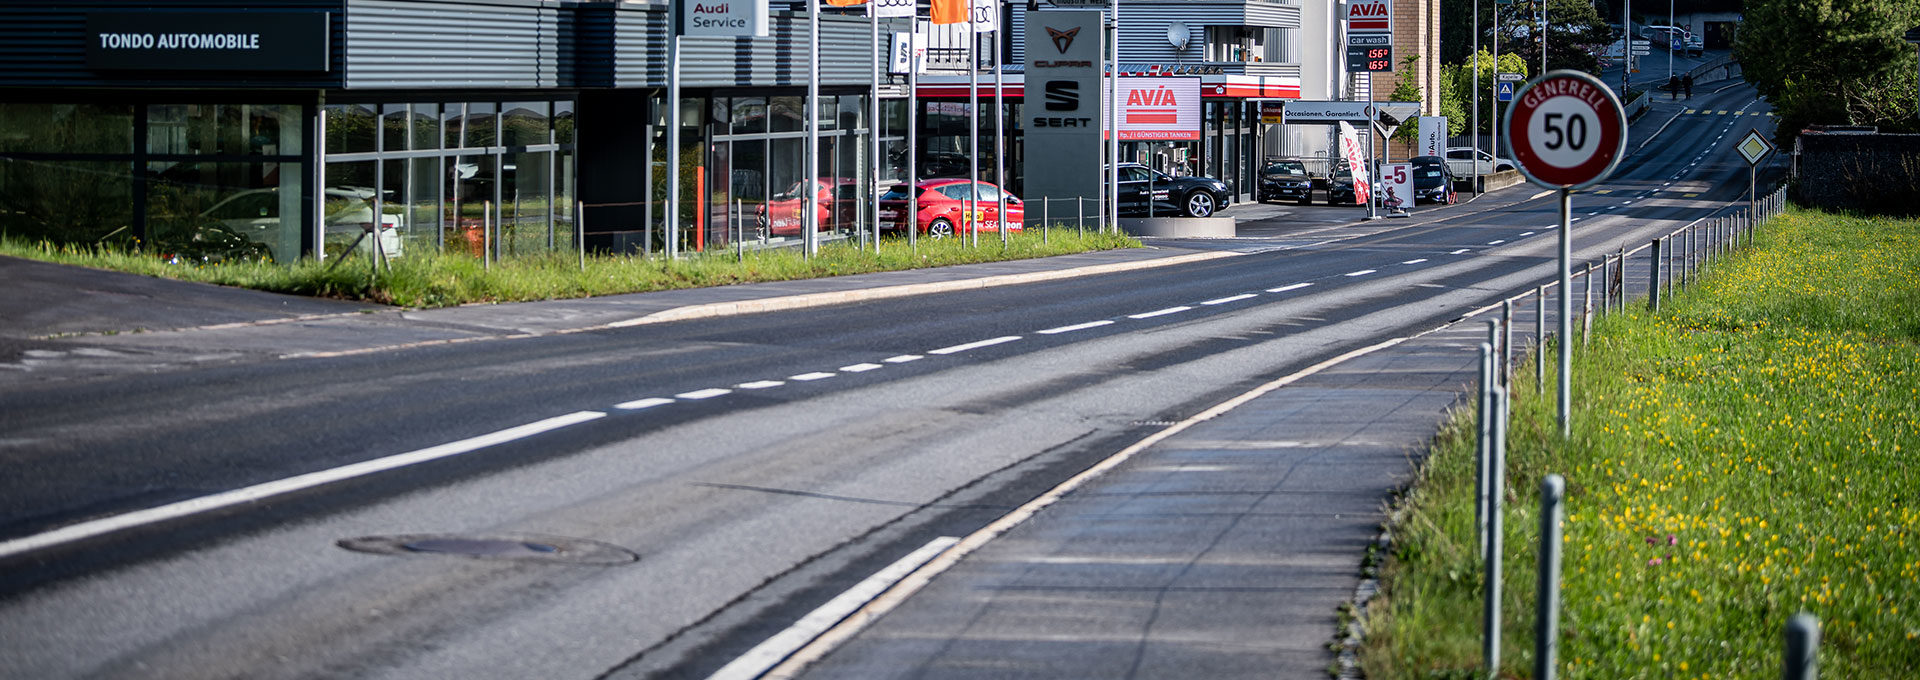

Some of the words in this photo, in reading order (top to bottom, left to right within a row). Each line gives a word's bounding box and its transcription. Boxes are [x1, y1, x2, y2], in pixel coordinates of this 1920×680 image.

[694, 3, 728, 13] Audi
[1350, 1, 1388, 16] AVIA
[693, 16, 746, 28] Service
[100, 33, 154, 49] TONDO
[157, 33, 260, 49] AUTOMOBILE
[1034, 60, 1092, 68] CUPRA
[1126, 85, 1177, 106] AVIA
[1524, 79, 1605, 110] GENERELL
[1285, 109, 1323, 117] Occasionen.
[1325, 109, 1361, 117] Garantiert.
[1033, 117, 1091, 127] SEAT
[1544, 113, 1587, 151] 50
